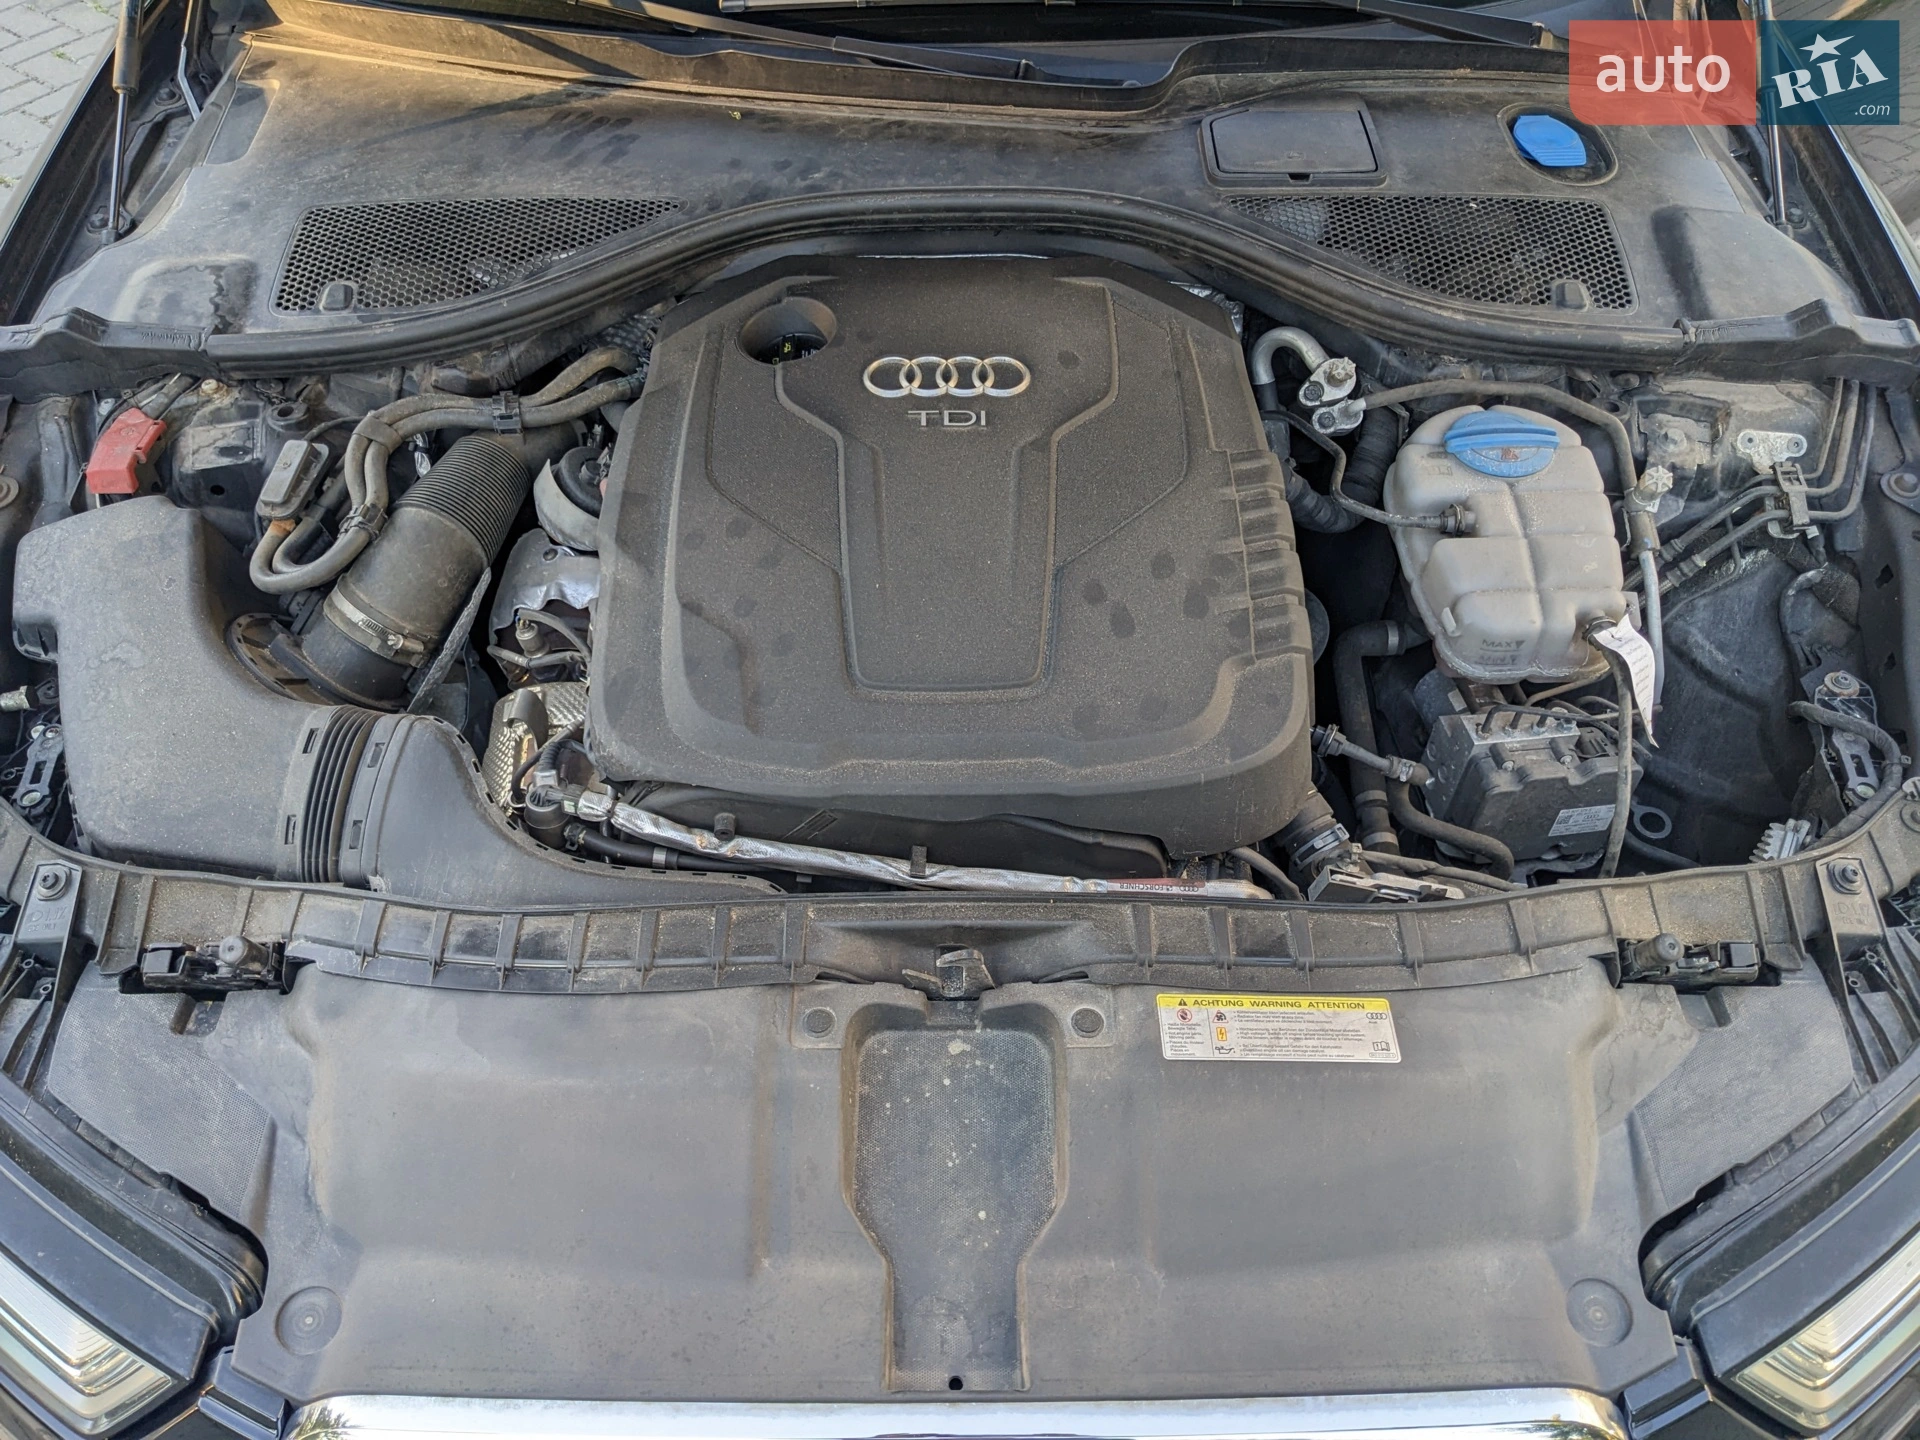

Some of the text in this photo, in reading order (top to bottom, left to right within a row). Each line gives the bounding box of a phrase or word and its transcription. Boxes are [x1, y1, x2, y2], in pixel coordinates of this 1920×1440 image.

[907, 410, 986, 426] TDI
[1482, 639, 1513, 648] MAX
[1193, 999, 1365, 1010] ACHTUNG WARNING ATTENTION
